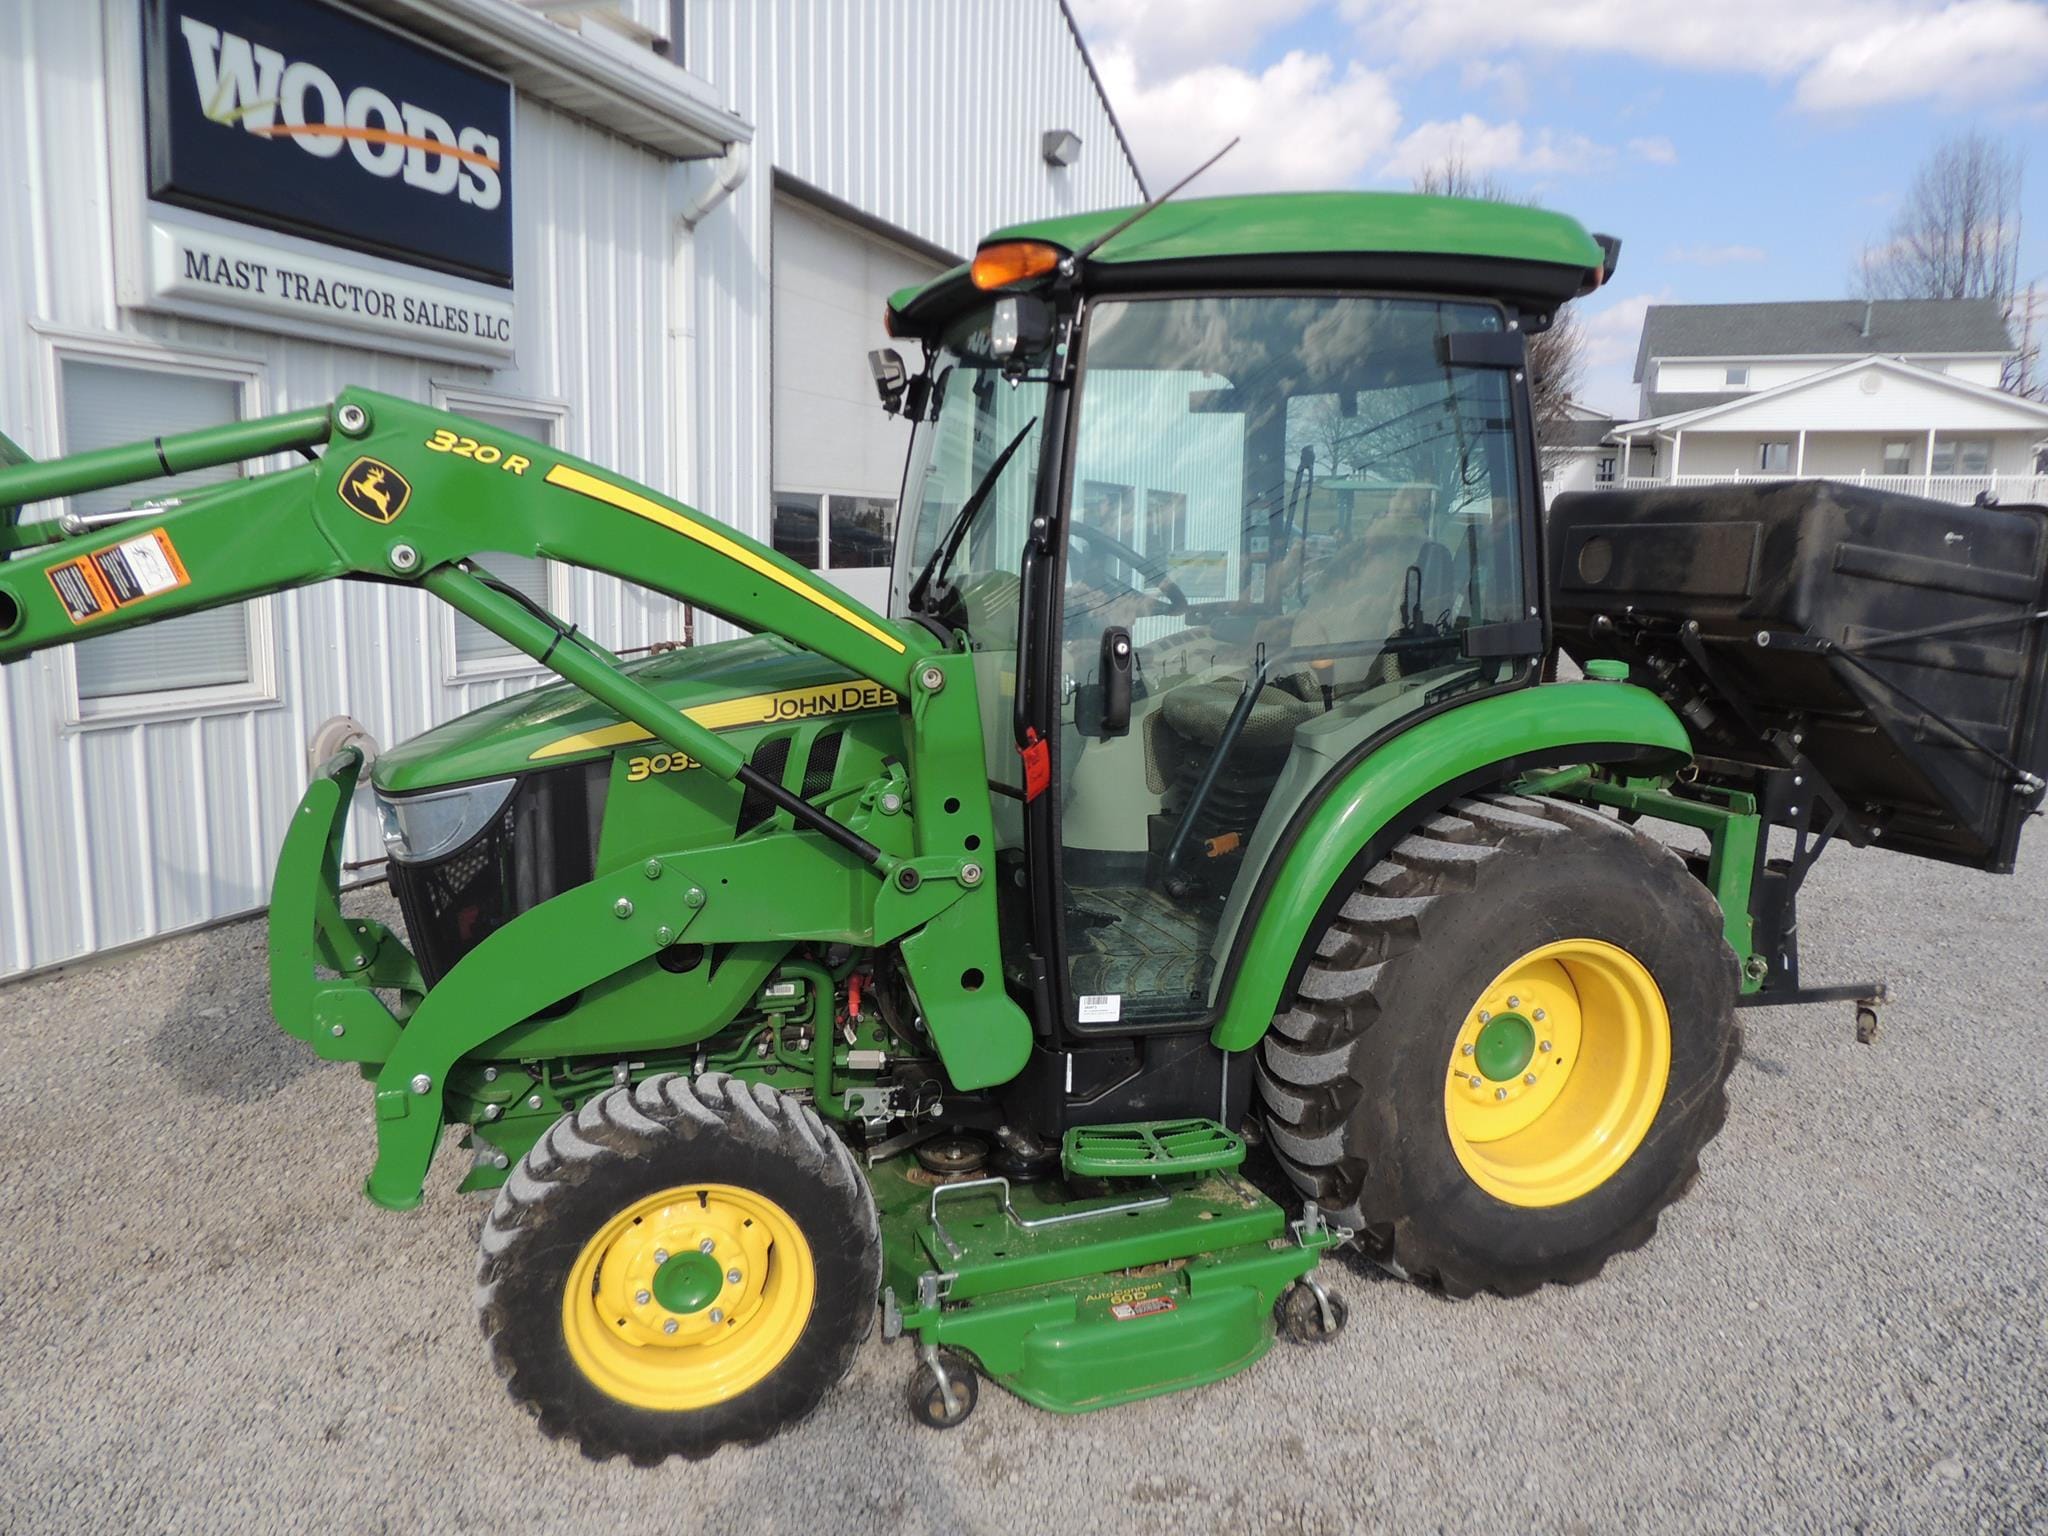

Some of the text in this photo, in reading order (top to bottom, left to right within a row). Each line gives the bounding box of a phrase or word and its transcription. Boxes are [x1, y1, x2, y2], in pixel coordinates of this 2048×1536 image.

[181, 15, 501, 210] WOODS
[183, 248, 510, 342] MAST TRACTOR SALES LLC
[424, 428, 531, 476] 320 R
[763, 693, 837, 719] JOHN
